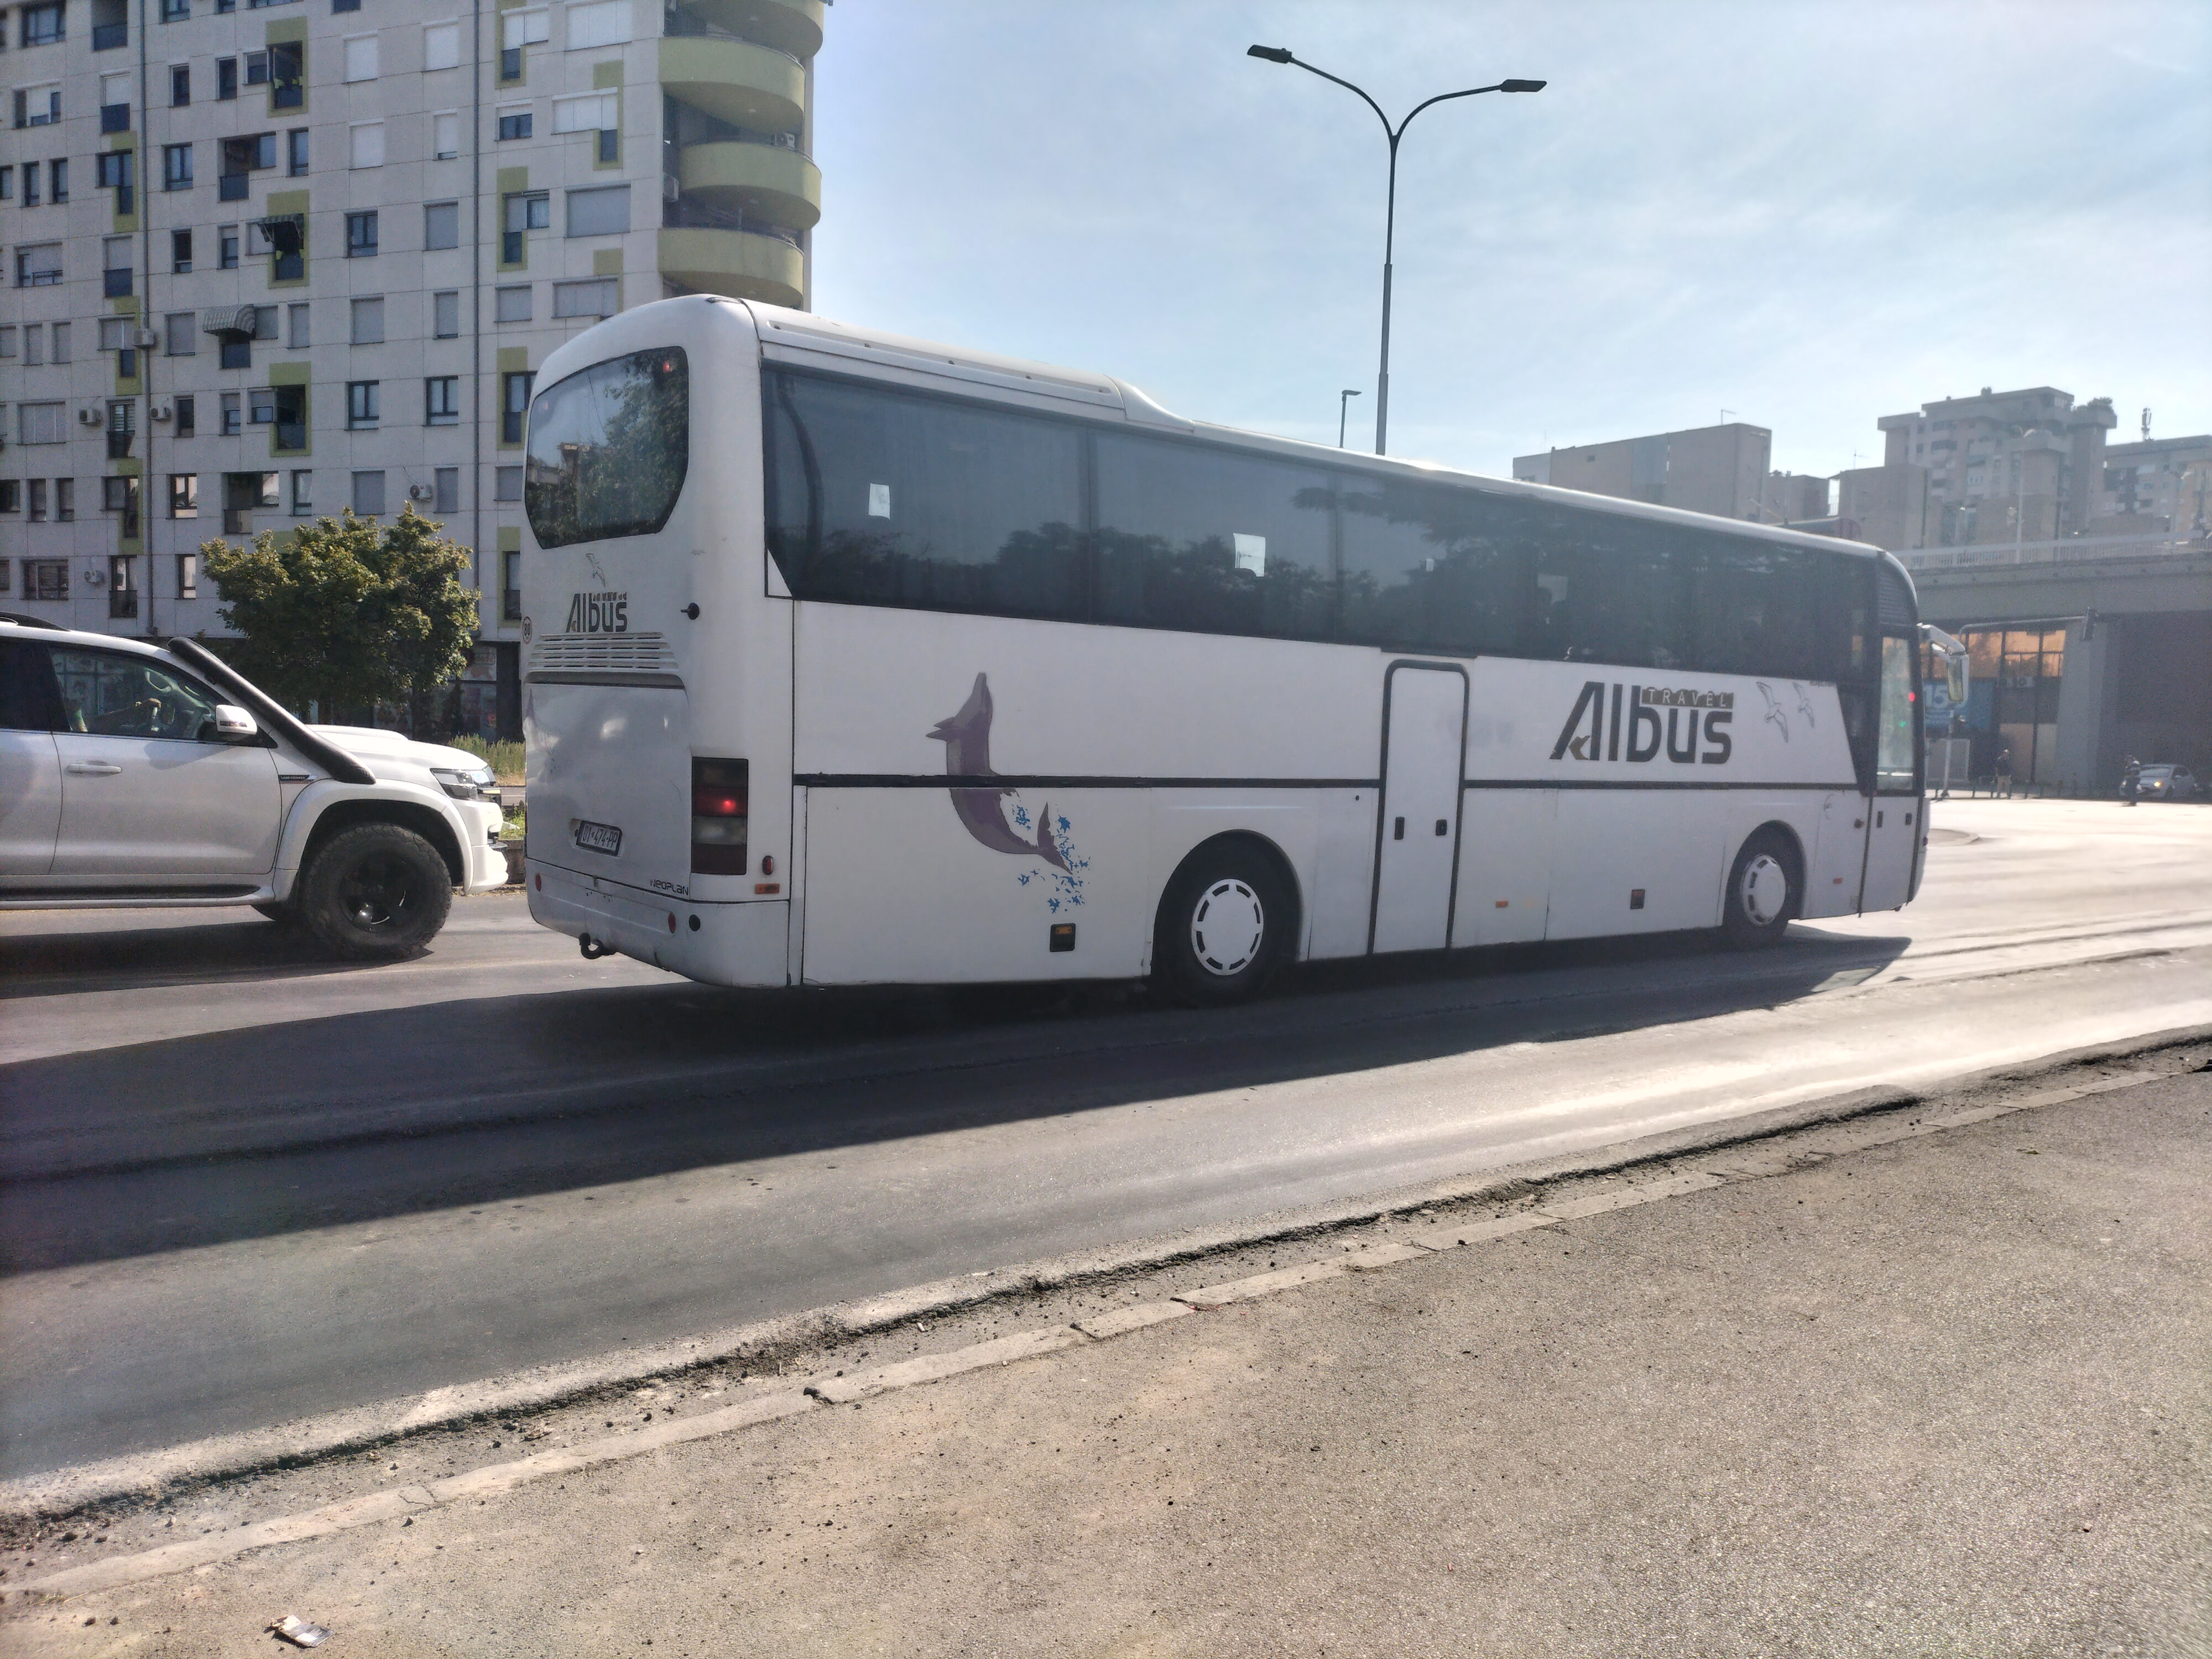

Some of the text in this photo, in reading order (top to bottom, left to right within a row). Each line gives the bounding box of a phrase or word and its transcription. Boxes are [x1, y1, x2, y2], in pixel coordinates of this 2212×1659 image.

[565, 592, 628, 633] Albus
[524, 623, 530, 636] 80
[1648, 691, 1727, 707] TRAVEL
[1549, 681, 1733, 764] Albus
